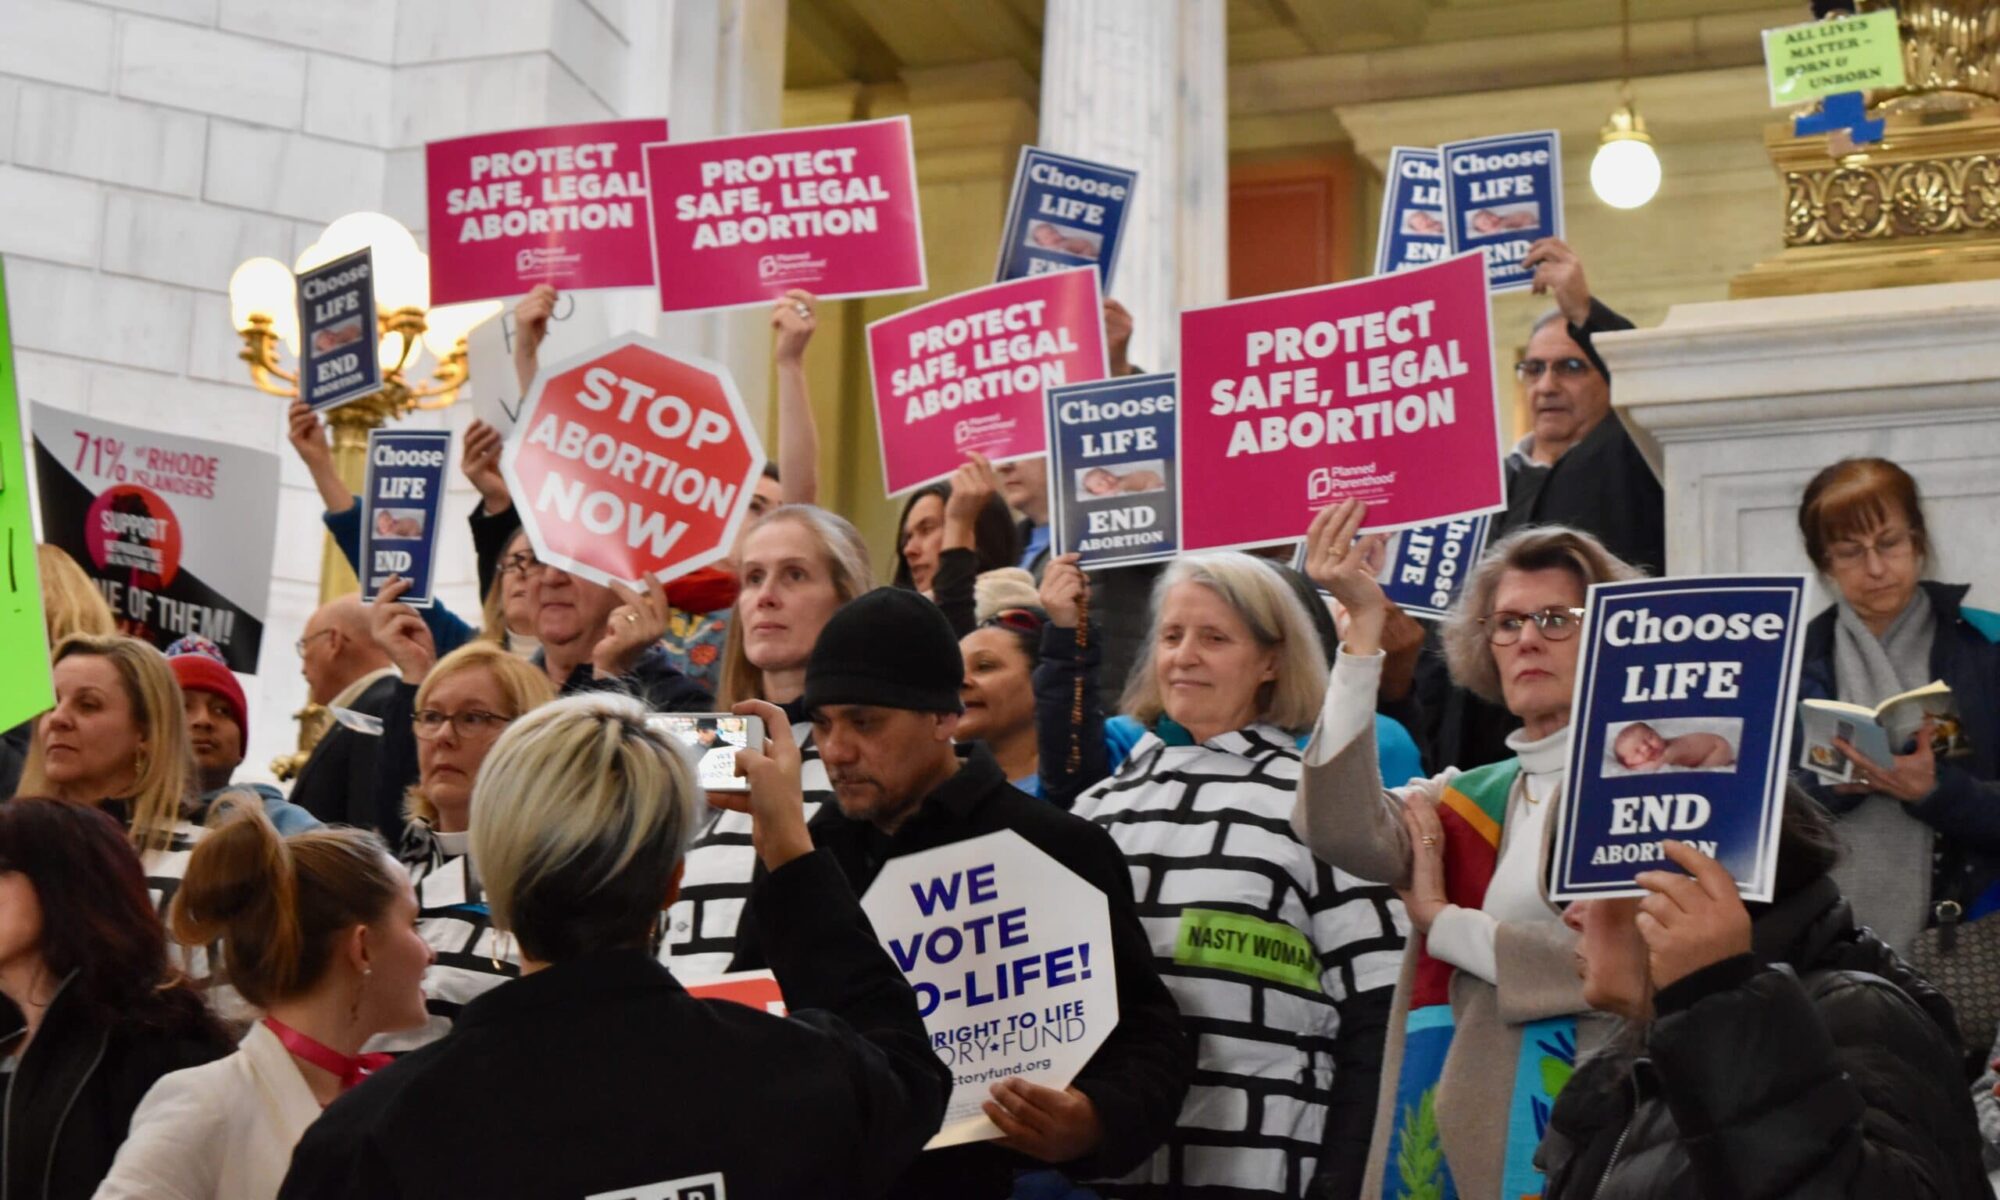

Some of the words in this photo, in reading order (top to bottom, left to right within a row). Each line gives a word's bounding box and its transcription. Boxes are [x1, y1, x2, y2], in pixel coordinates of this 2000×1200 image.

[1785, 29, 1815, 45] ALL
[1820, 19, 1868, 38] LIVES
[1789, 37, 1859, 59] MATTER
[1784, 58, 1831, 77] BORN
[1808, 66, 1882, 89] UNBORN
[471, 143, 618, 181] PROTECT
[701, 147, 857, 187] PROTECT
[1402, 159, 1443, 180] Cho
[1453, 149, 1549, 176] Choose
[447, 181, 534, 215] SAFE,
[542, 171, 648, 202] LEGAL
[675, 187, 773, 221] SAFE,
[780, 175, 890, 209] LEGAL
[1030, 162, 1126, 201] Choose
[1469, 174, 1534, 203] LIFE
[458, 202, 634, 244] ABORTION
[692, 206, 878, 250] ABORTION
[1038, 193, 1105, 226] LIFE
[303, 262, 370, 300] Choose
[315, 289, 360, 324] LIFE
[908, 299, 1046, 359] PROTECT
[1246, 299, 1435, 367] PROTECT
[317, 352, 360, 384] END
[891, 351, 967, 397] SAFE,
[973, 326, 1078, 370] LEGAL
[1209, 367, 1333, 416] SAFE,
[1346, 339, 1469, 397] LEGAL
[575, 366, 732, 450] STOP
[904, 359, 1066, 425] ABORTION
[1059, 394, 1175, 425] Choose
[1226, 387, 1456, 458] ABORTION
[74, 430, 127, 482] 71%
[146, 447, 219, 481] RHODE
[374, 444, 444, 467] Choose
[1081, 426, 1158, 458] LIFE
[132, 469, 215, 500] ISLANDERS
[528, 413, 737, 519] ABORTION
[1331, 461, 1376, 477] Planned
[378, 476, 427, 499] LIFE
[101, 510, 169, 543] SUPPORT
[535, 470, 690, 559] NOW
[1087, 505, 1156, 534] END
[1078, 530, 1164, 552] ABORTION
[374, 550, 412, 573] END
[1429, 518, 1473, 608] hoose
[128, 585, 153, 622] OF
[157, 595, 235, 645] THEM!
[1604, 608, 1785, 647] Choose
[1622, 661, 1742, 704] LIFE
[1608, 793, 1711, 835] END
[1591, 840, 1718, 865] ABORTON
[909, 863, 999, 917] WE
[888, 906, 1030, 974] VOTE
[1188, 926, 1249, 954] NASTY
[912, 942, 1092, 1019] O-LIFE!
[1007, 1011, 1037, 1032] TO
[1044, 1000, 1085, 1024] LIFE
[952, 1058, 1052, 1088] ctoryfund.org
